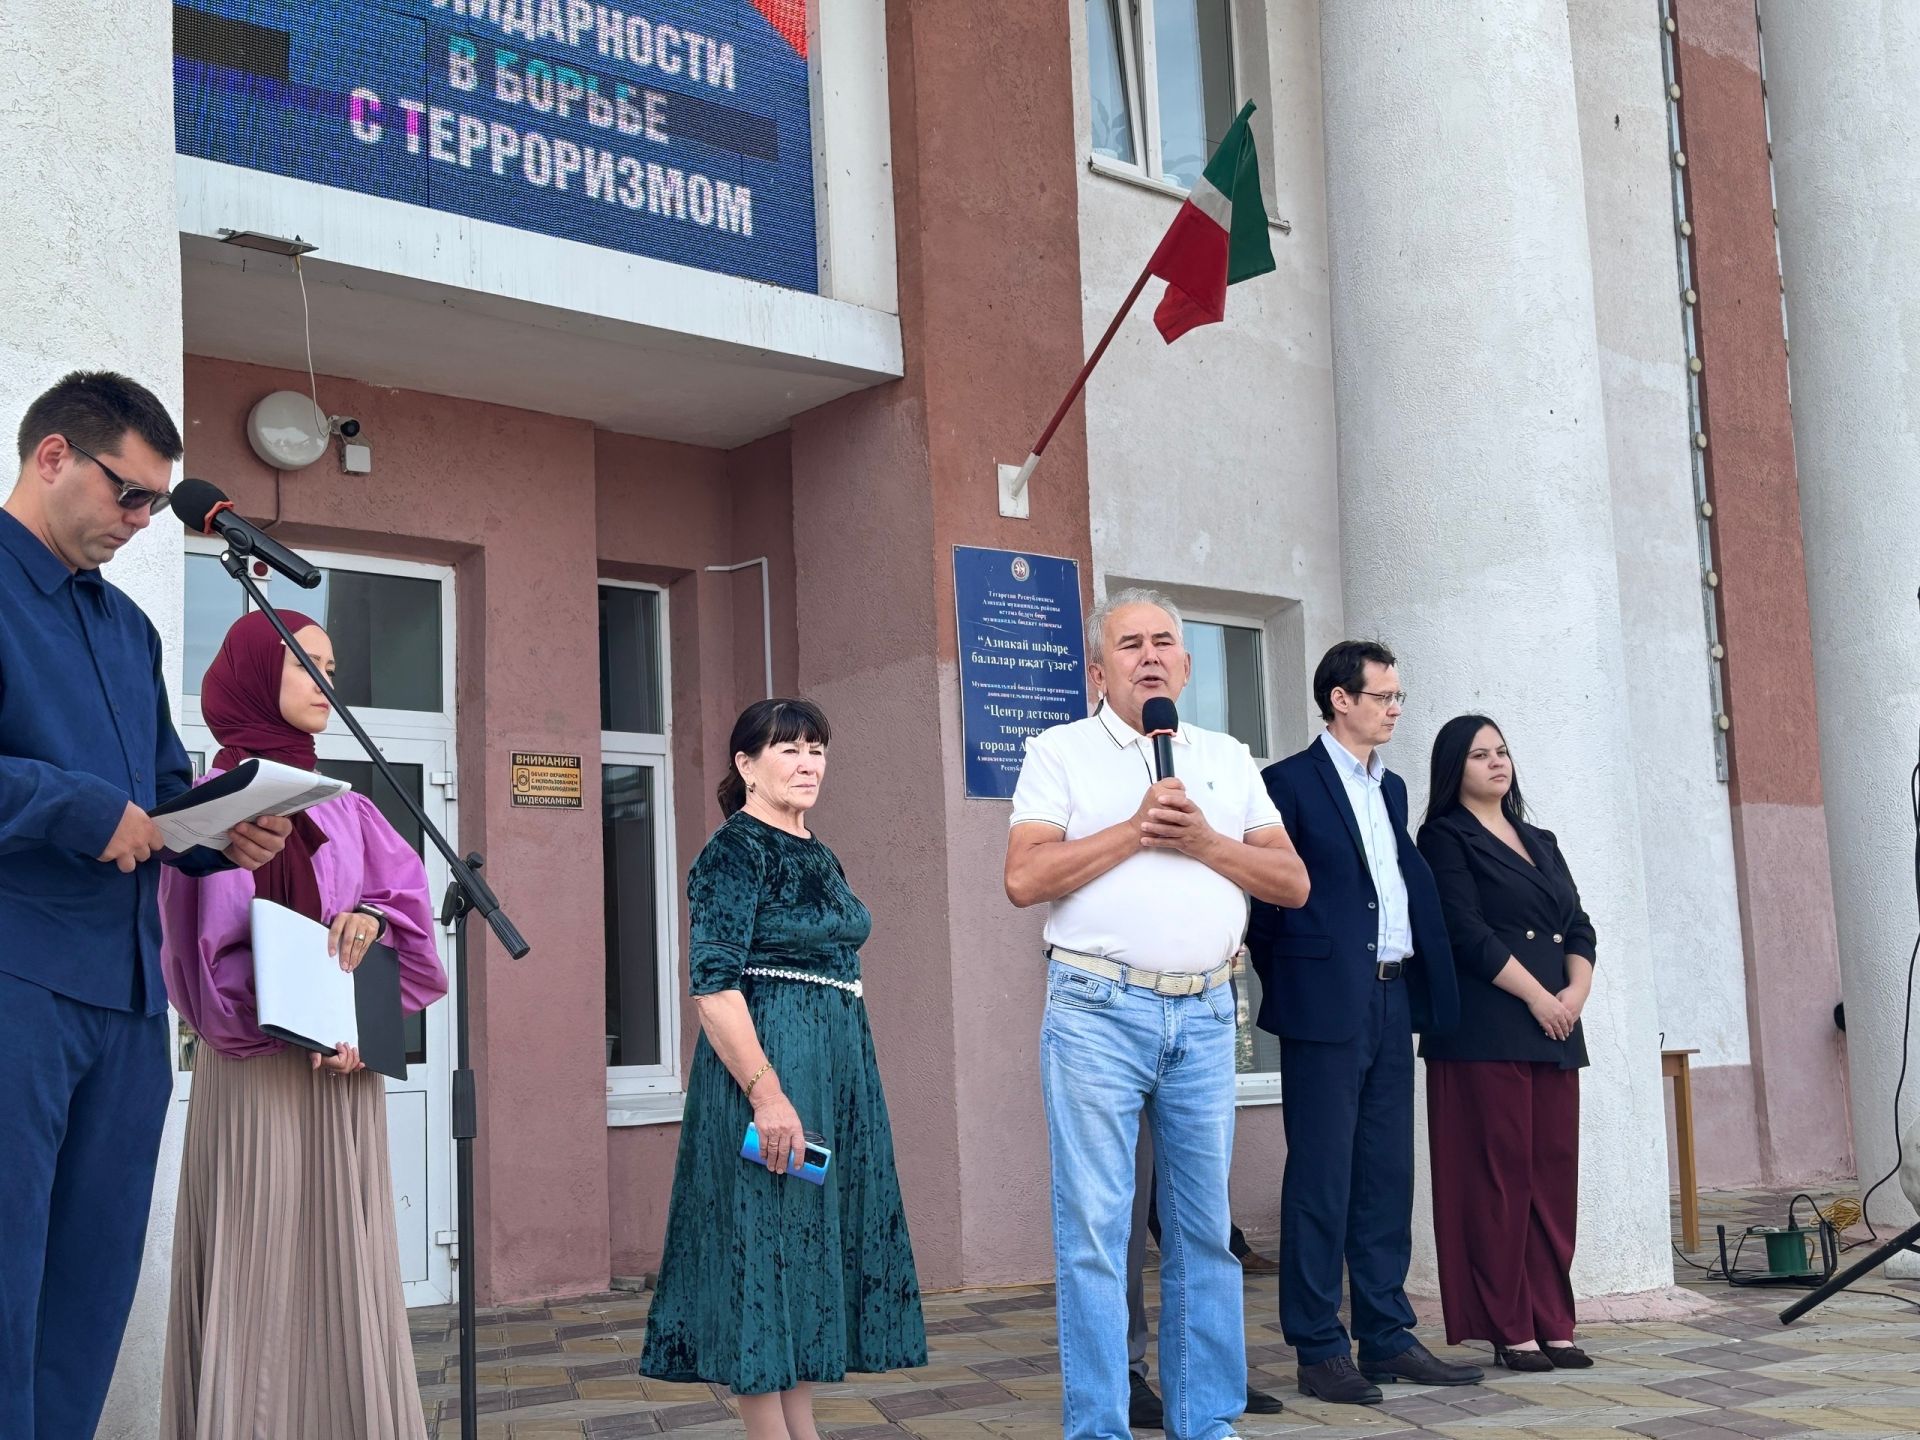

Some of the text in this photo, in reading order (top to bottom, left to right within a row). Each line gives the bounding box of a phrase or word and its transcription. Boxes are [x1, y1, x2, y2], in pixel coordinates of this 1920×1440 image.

[432, 0, 736, 91] ДАРНОСТИ
[449, 34, 671, 144] В БОРЬБЕ
[349, 87, 754, 236] С ТЕРРОРИЗМОМ
[1032, 641, 1069, 657] шәһәре
[971, 651, 1016, 669] балалар
[1018, 658, 1044, 669] иҗат
[1026, 709, 1070, 721] детского
[980, 741, 1016, 754] города
[516, 754, 577, 767] ВНИМАНИЕ!
[517, 795, 579, 806] ВИДЕОКАМЕРА!
